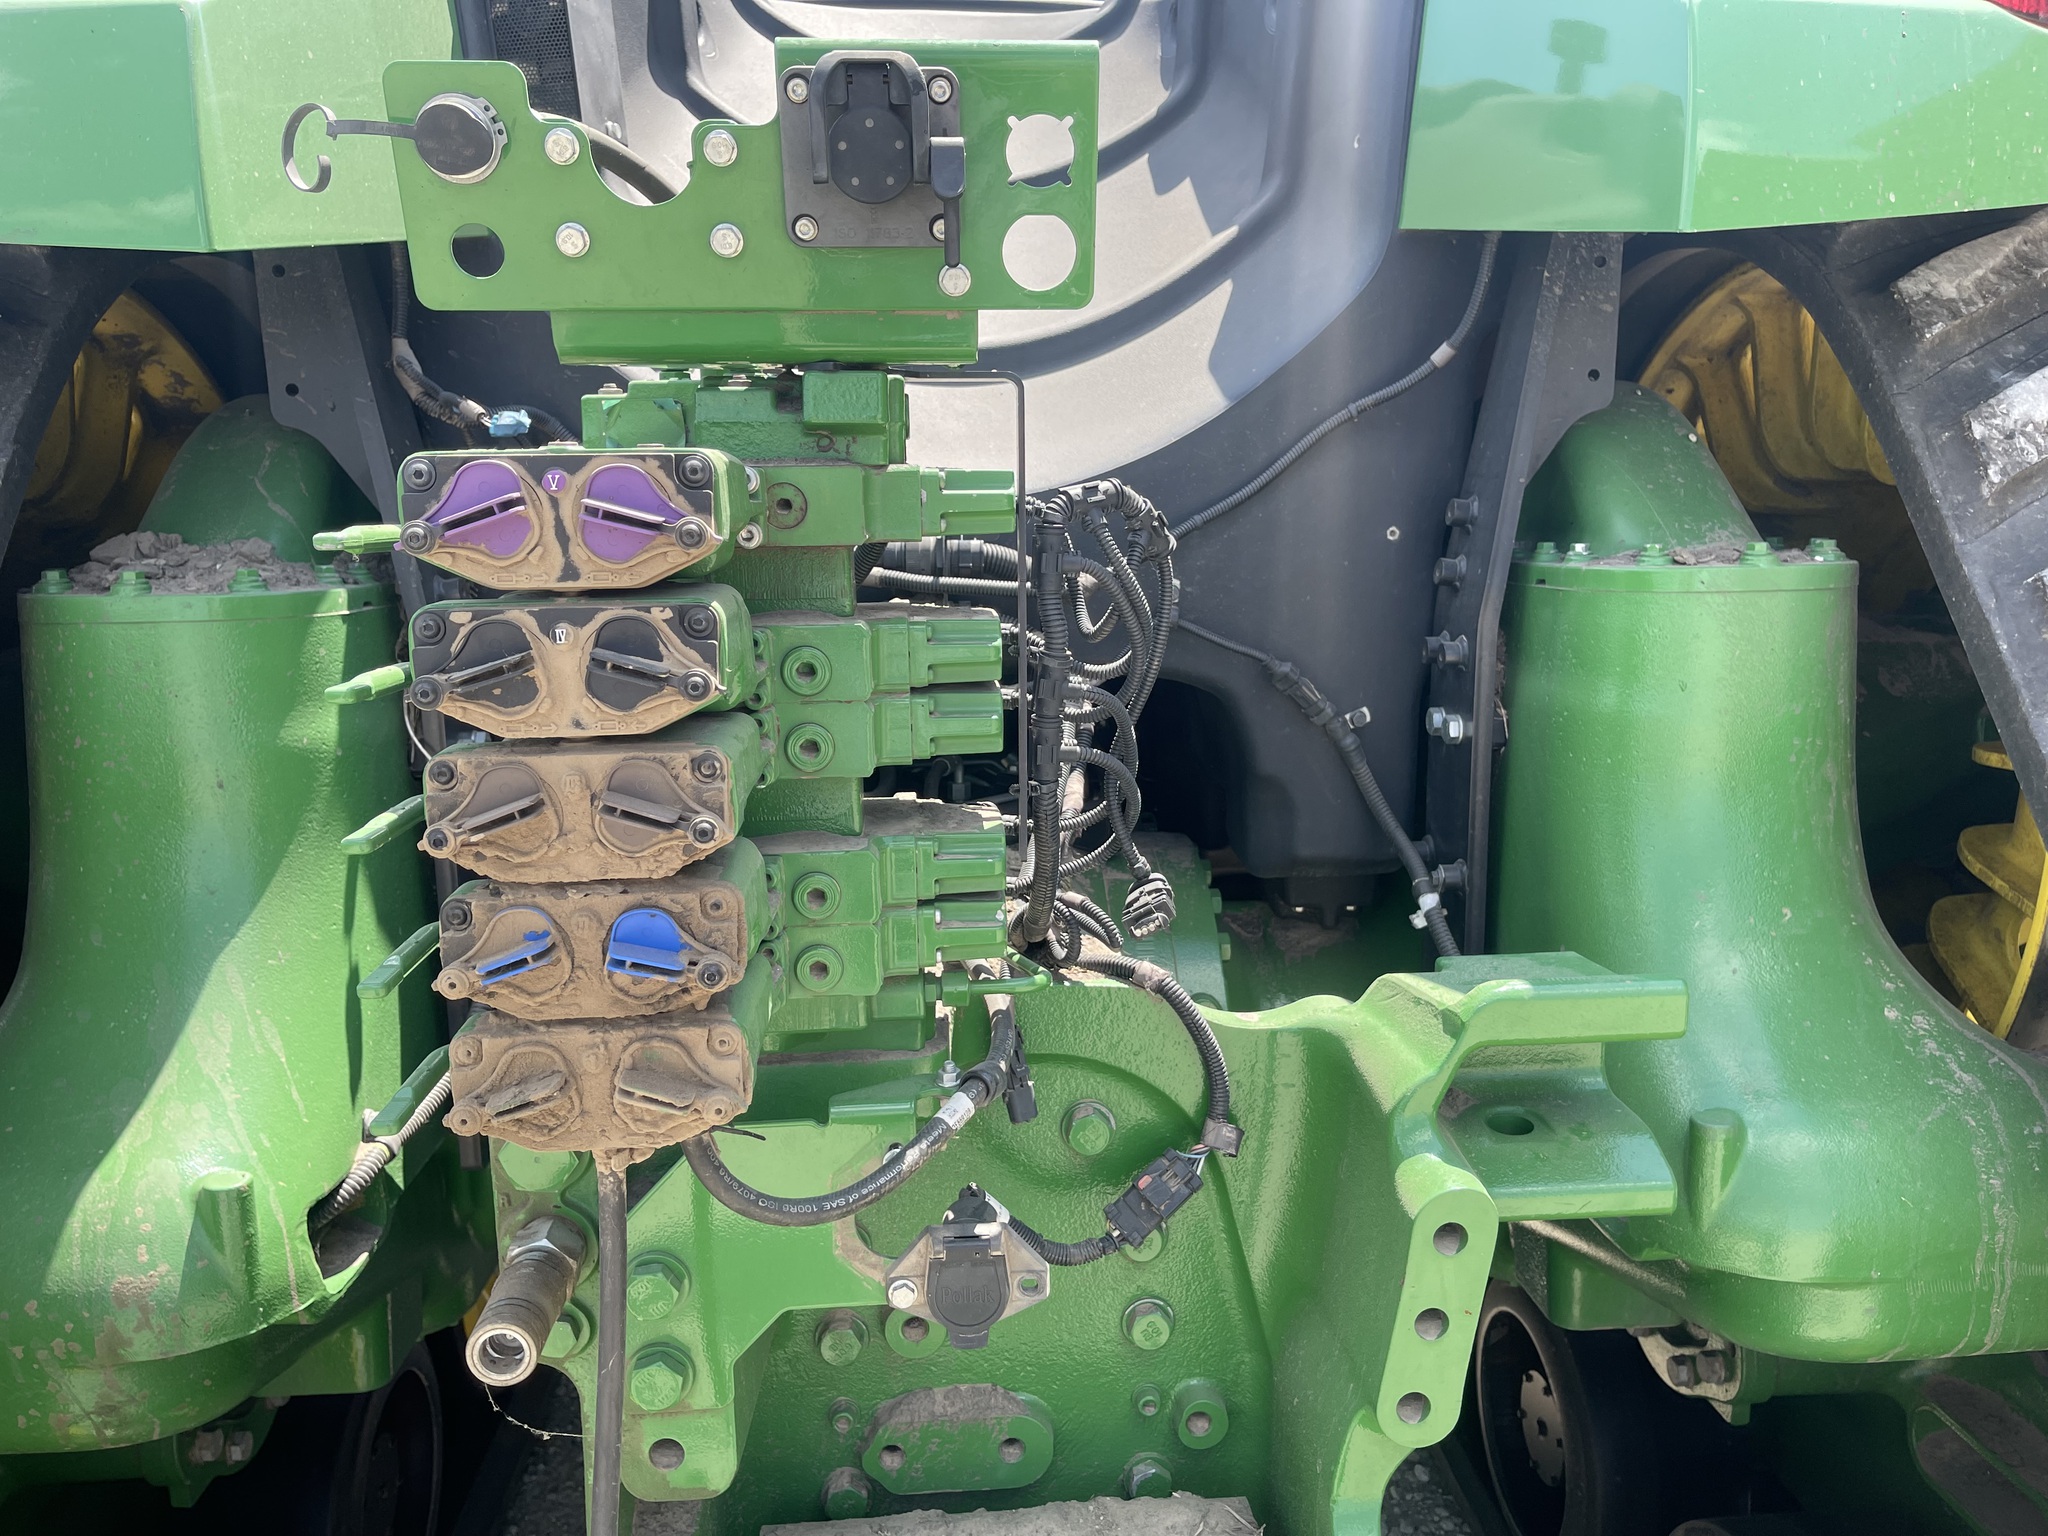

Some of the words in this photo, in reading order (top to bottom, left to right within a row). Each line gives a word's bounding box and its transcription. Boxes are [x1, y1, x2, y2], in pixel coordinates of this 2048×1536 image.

[834, 227, 857, 239] ISO
[547, 475, 560, 490] V
[555, 629, 567, 644] IV
[921, 1123, 947, 1149] Meets
[861, 1149, 920, 1195] Performance
[718, 1167, 756, 1201] 4079/R6
[758, 1198, 778, 1210] ISO
[822, 1198, 846, 1211] SAE
[848, 1192, 859, 1202] of
[782, 1204, 818, 1213] 100R6
[941, 1284, 995, 1305] Pollak
